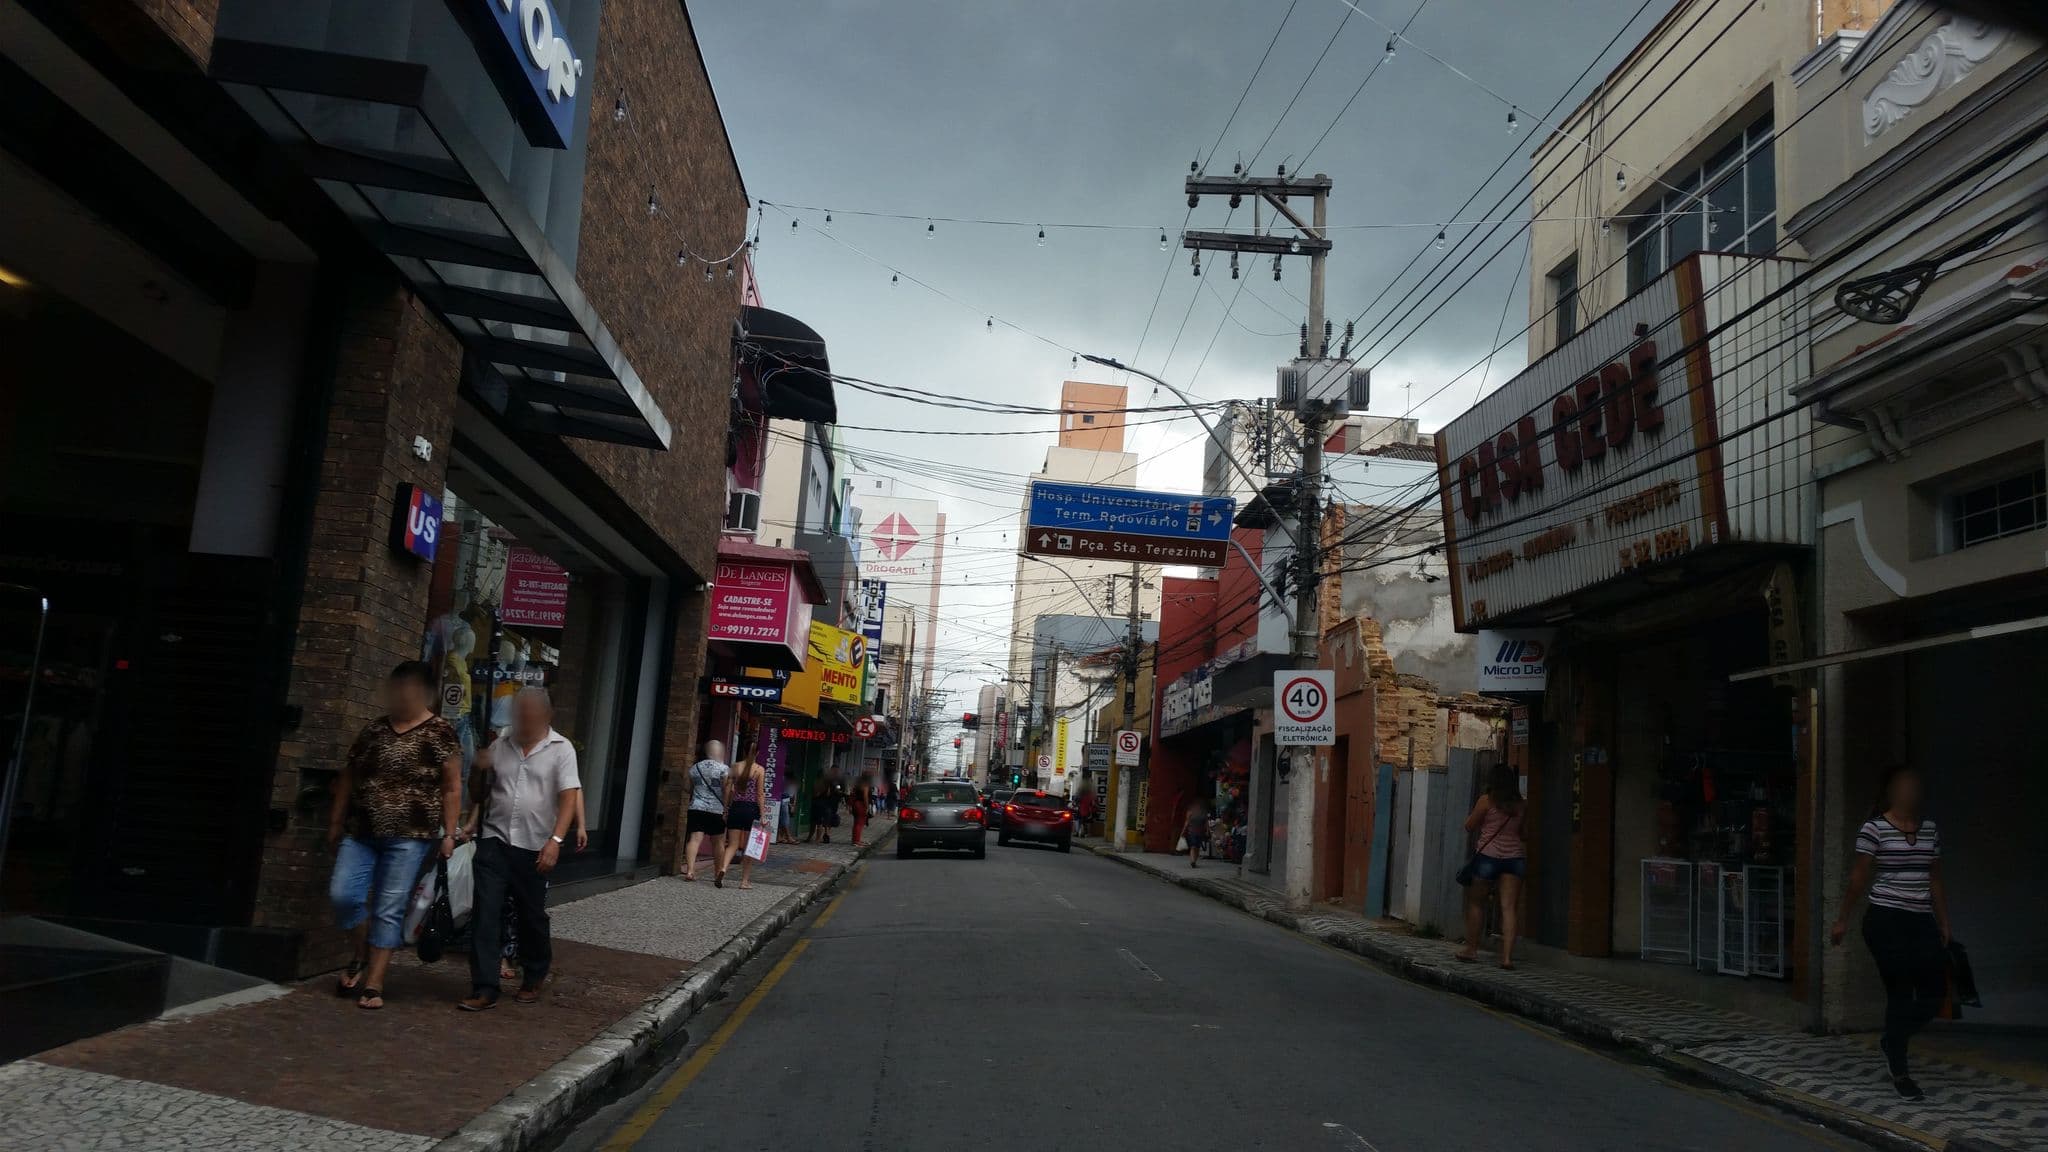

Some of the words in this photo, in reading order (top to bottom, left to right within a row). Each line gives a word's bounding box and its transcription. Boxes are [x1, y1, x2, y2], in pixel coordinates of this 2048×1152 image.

[498, 0, 567, 104] OP
[1459, 416, 1544, 521] CASA
[1038, 488, 1075, 504] Hosp.
[1081, 493, 1182, 512] Universitário
[410, 505, 436, 543] US
[1055, 507, 1095, 521] Term.
[1100, 511, 1180, 529] Rodoviário
[1079, 538, 1109, 553] Pça.
[1113, 541, 1142, 555] Sta.
[1146, 543, 1217, 560] Terezinha
[866, 564, 918, 575] DROGASIL
[723, 595, 773, 606] CADASTRE-SE
[867, 579, 879, 619] HOTEL
[727, 624, 780, 637] 99191.7274
[1484, 665, 1520, 675] Micro
[715, 684, 777, 698] USTOP
[1290, 688, 1320, 707] 40
[1278, 725, 1333, 733] FISCALIZAÇÃO
[1282, 734, 1328, 742] ELETRÔNICA
[764, 727, 779, 798] ESTACIONAMENTO
[1090, 758, 1109, 766] HOTEL
